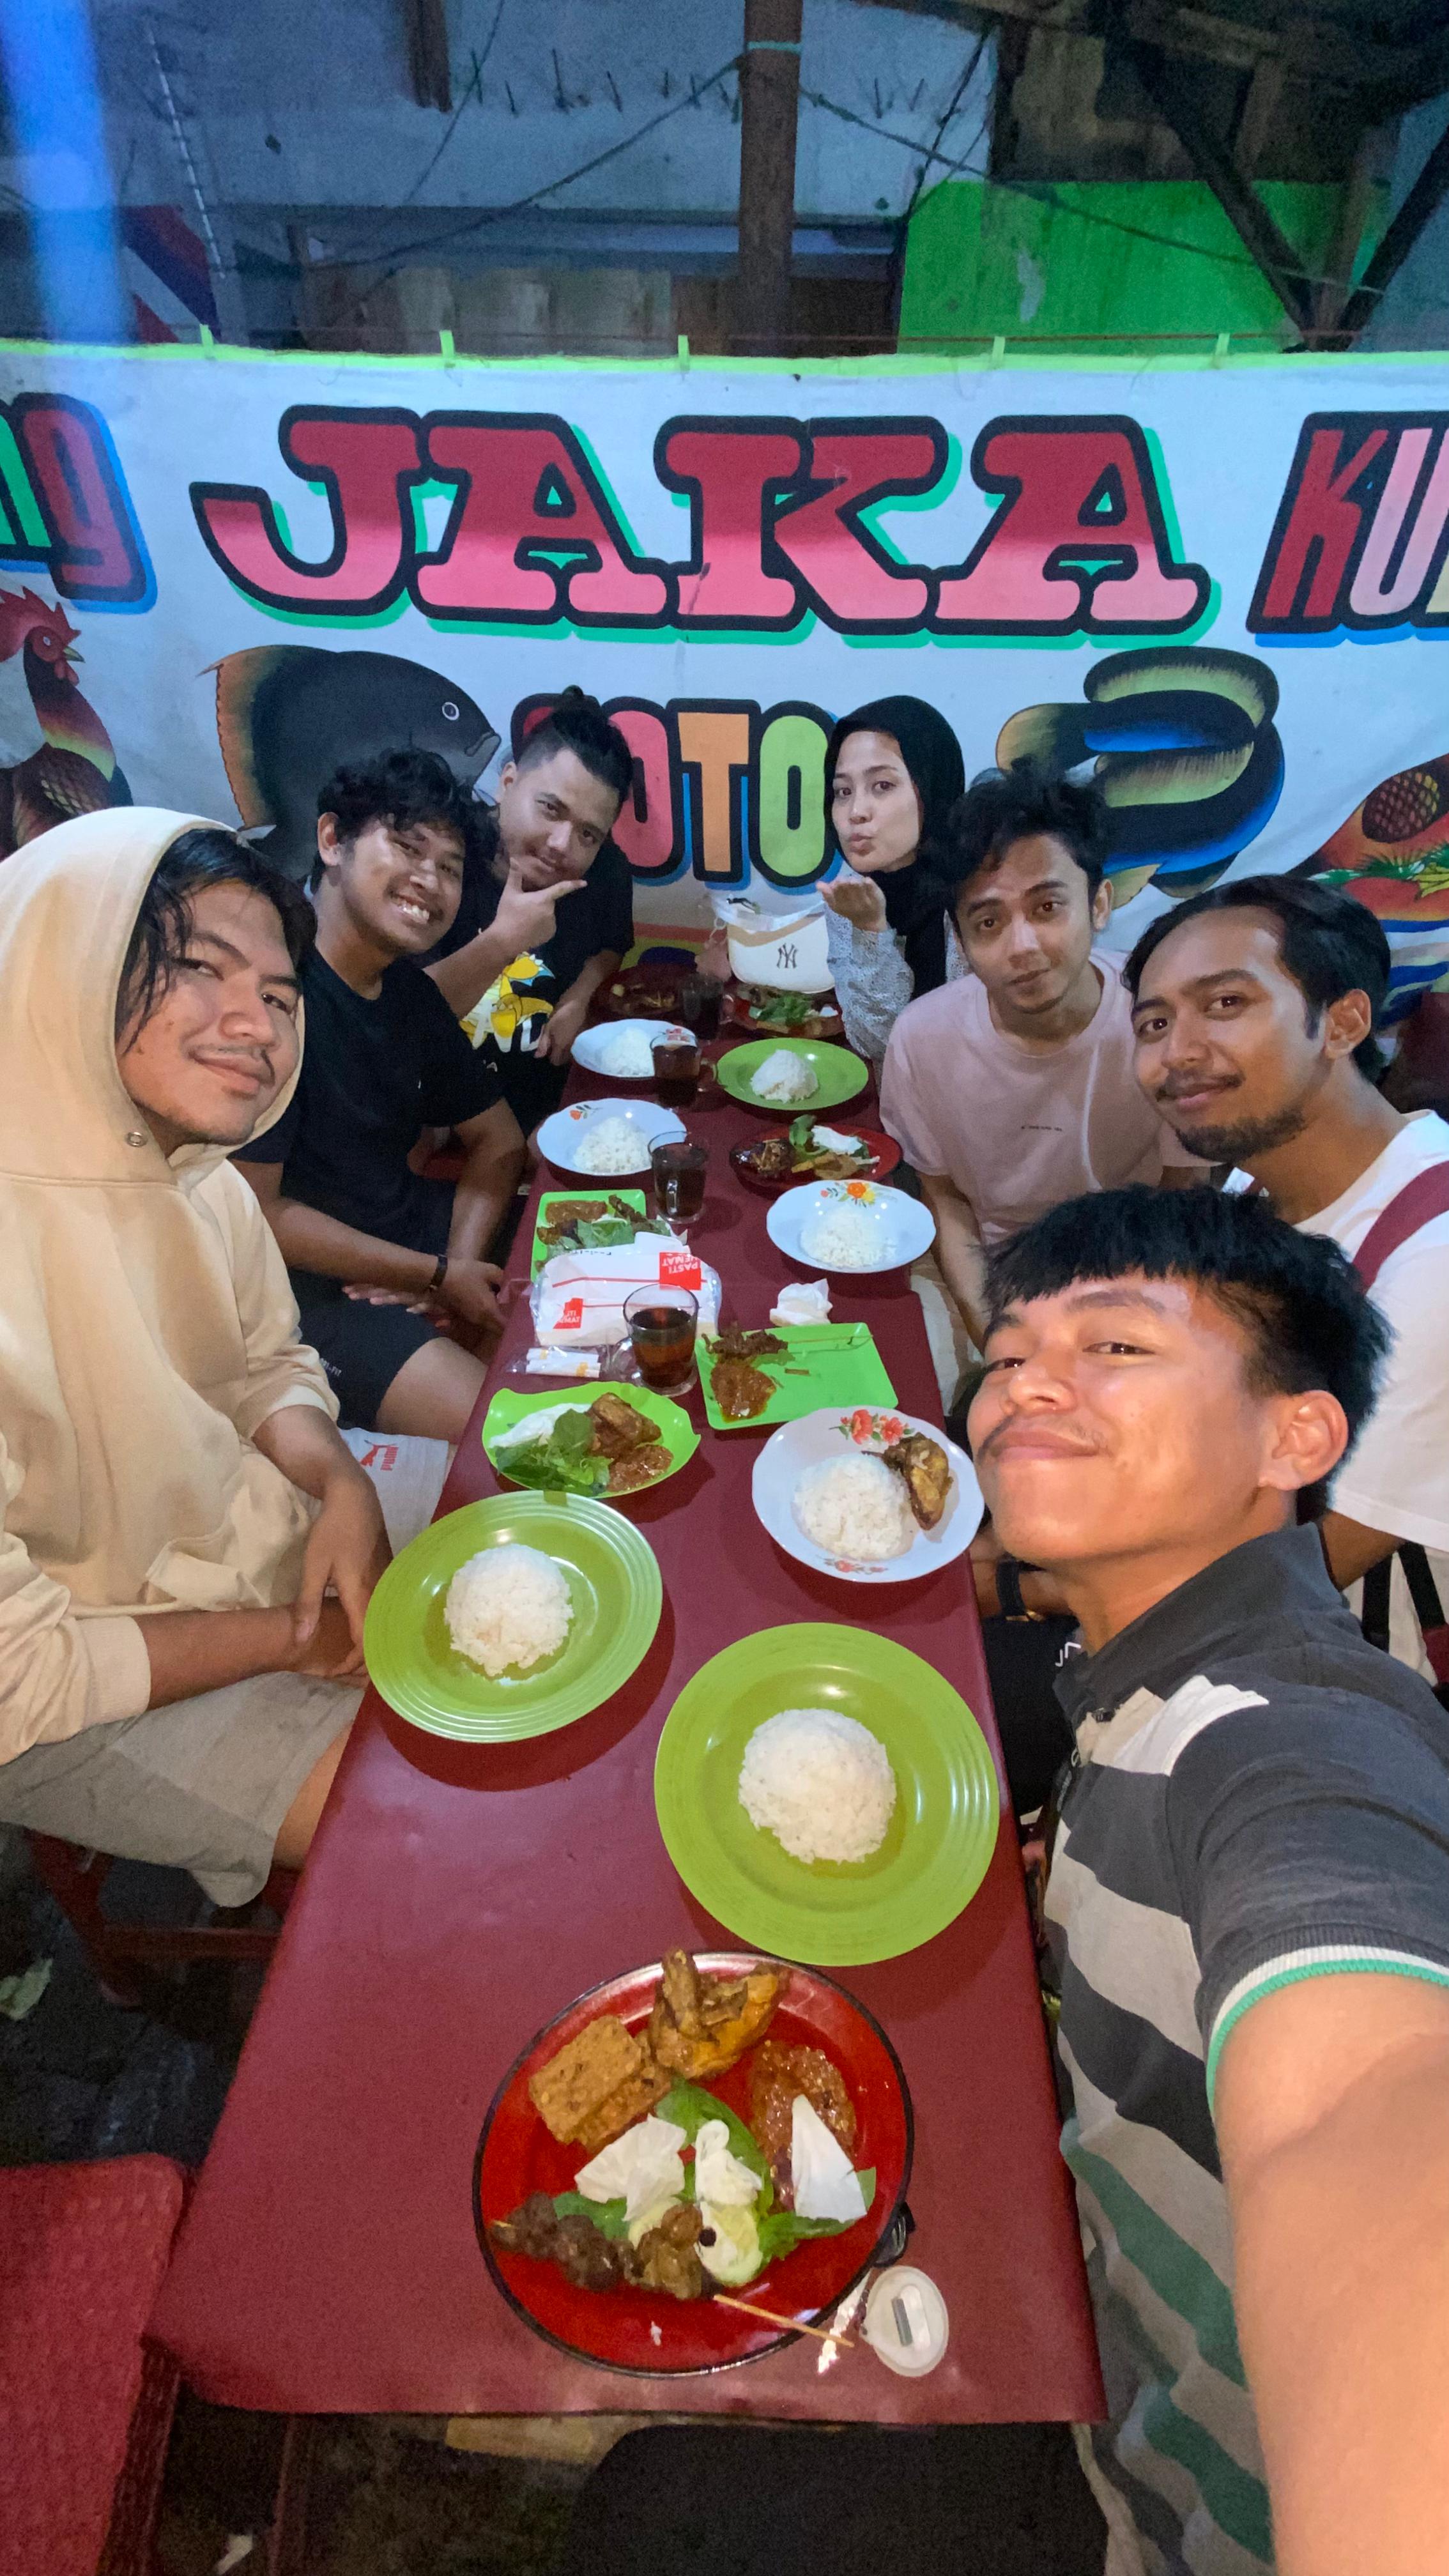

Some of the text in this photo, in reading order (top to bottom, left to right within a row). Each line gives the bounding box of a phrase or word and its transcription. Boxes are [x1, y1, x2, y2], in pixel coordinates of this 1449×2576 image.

[190, 404, 1216, 641] JAKA
[1246, 411, 1449, 638] KU
[510, 693, 841, 890] OTO
[776, 943, 798, 969] NY
[668, 1261, 698, 1275] PASTI
